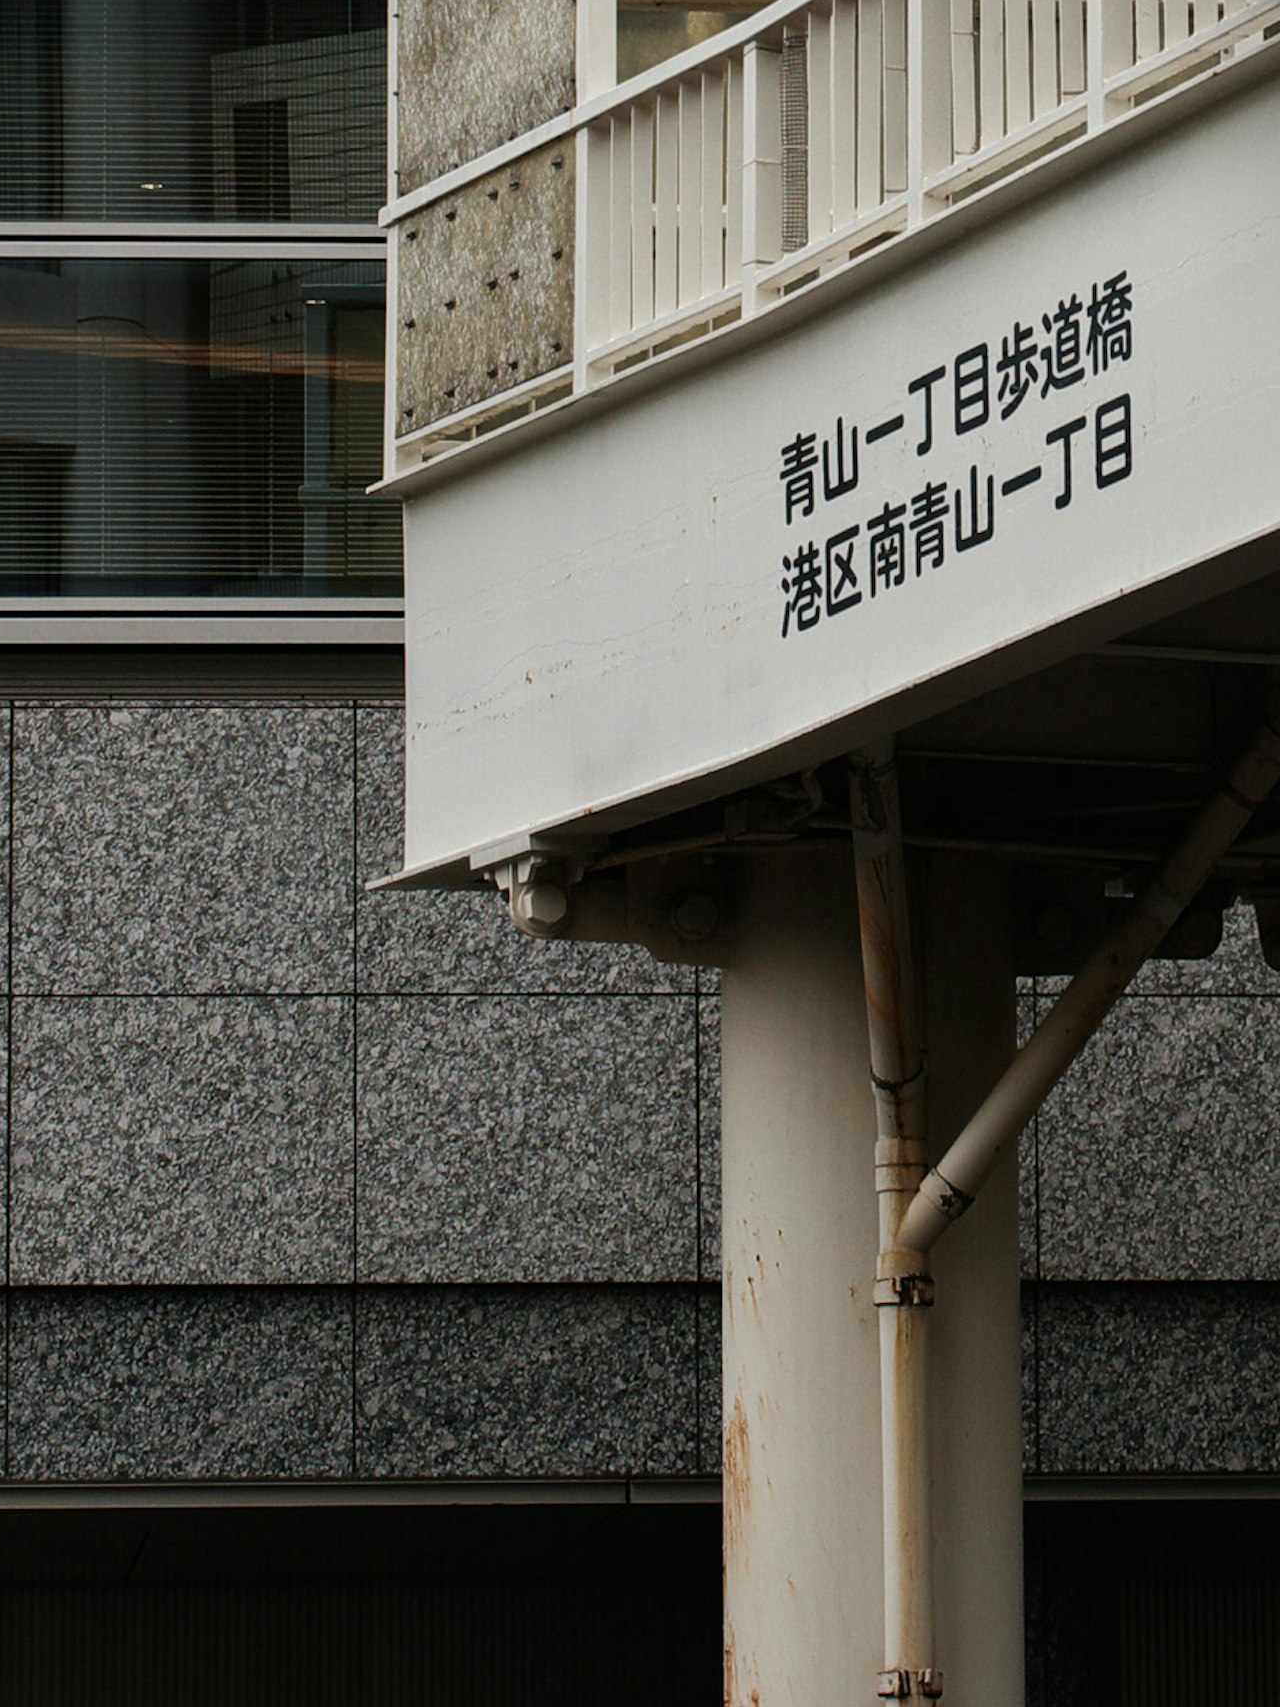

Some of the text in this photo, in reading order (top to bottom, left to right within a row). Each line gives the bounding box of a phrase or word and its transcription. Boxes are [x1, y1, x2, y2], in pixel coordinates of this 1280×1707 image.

[779, 270, 1133, 526] 青山一丁目歩道橋
[780, 393, 1133, 639] 港区南青山一丁目
